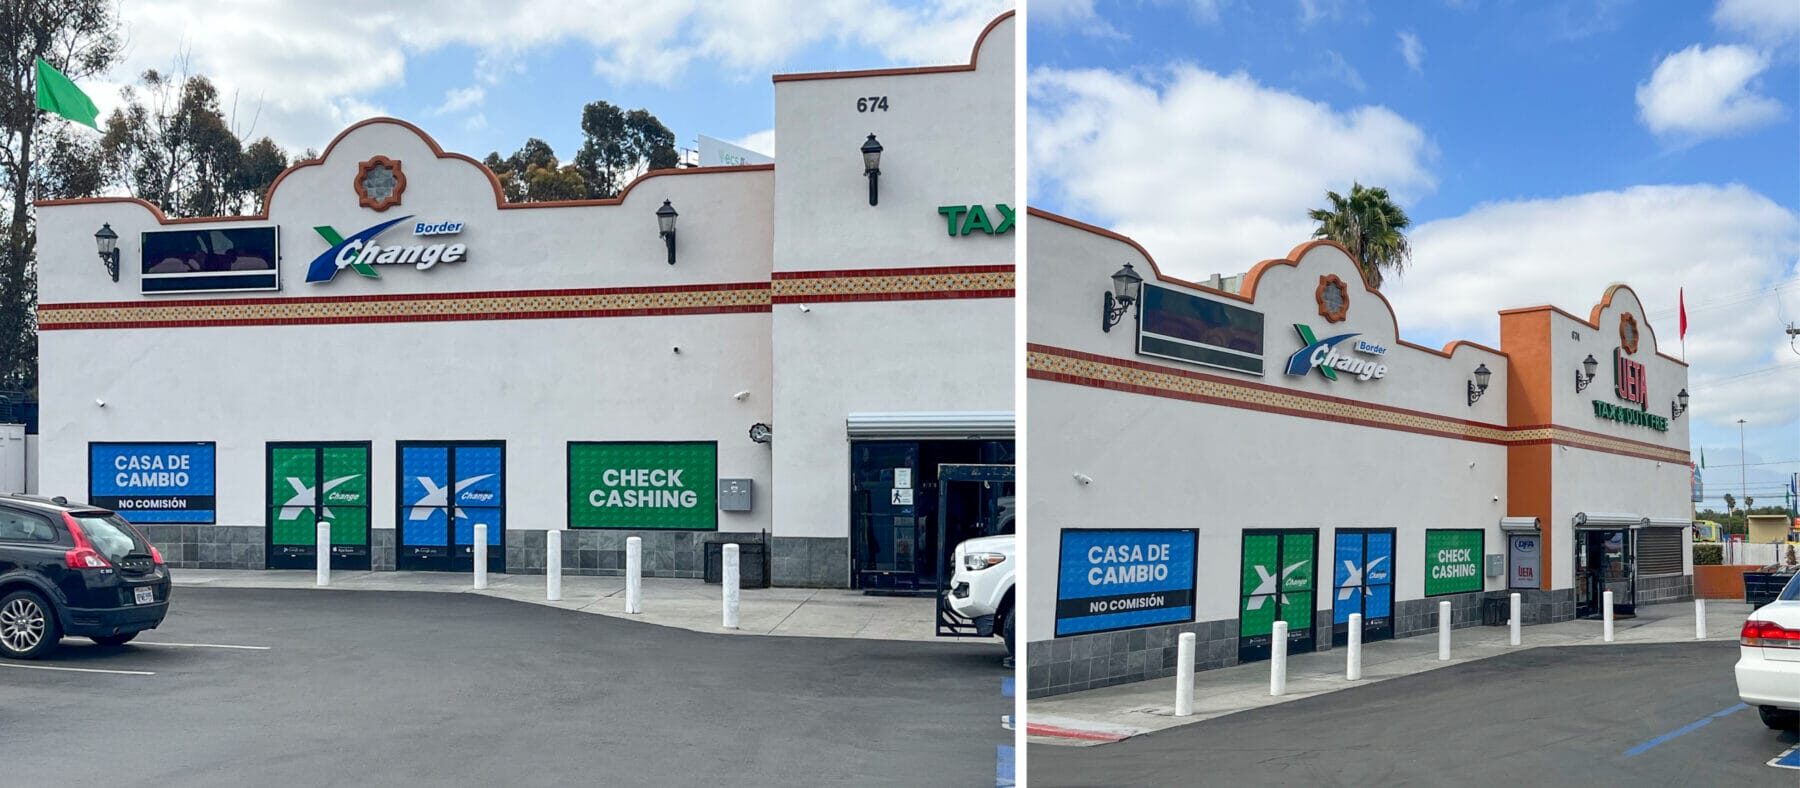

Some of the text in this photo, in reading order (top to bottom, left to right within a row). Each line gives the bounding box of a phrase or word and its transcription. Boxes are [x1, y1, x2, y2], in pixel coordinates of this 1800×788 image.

[856, 96, 889, 113] 674
[415, 220, 463, 236] Border
[938, 203, 1015, 237] TAX
[1359, 341, 1387, 355] Border
[1613, 346, 1648, 412] UETA
[1592, 400, 1617, 420] TAX
[1650, 414, 1669, 432] FREE
[114, 455, 190, 470] CASA DE
[116, 471, 190, 487] CAMBIO
[602, 468, 684, 488] CHECK
[119, 496, 187, 509] NO COMISIÓN
[588, 489, 698, 509] CASHING
[1087, 543, 1170, 564] CASA DE
[1437, 549, 1471, 563] CHECK
[1087, 564, 1168, 586] CAMBIO
[1432, 563, 1476, 580] CASHING
[1518, 565, 1534, 578] UETA
[1089, 594, 1165, 613] NO COMISIÓN
